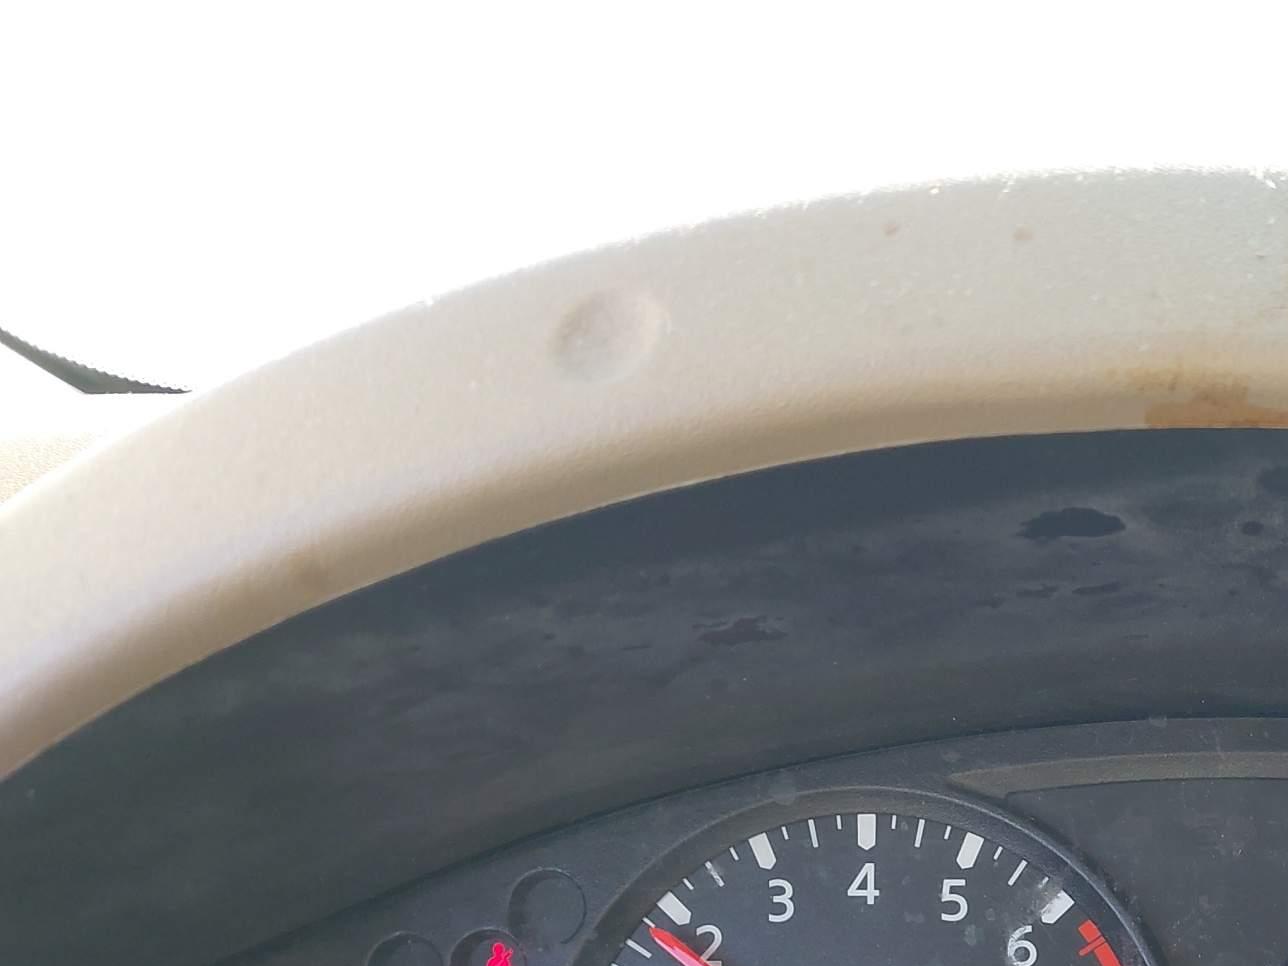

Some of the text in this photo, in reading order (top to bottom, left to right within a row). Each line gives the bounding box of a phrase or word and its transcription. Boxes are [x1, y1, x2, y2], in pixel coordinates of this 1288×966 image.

[766, 878, 796, 922] 3
[847, 862, 880, 905] 4
[940, 878, 969, 922] 5
